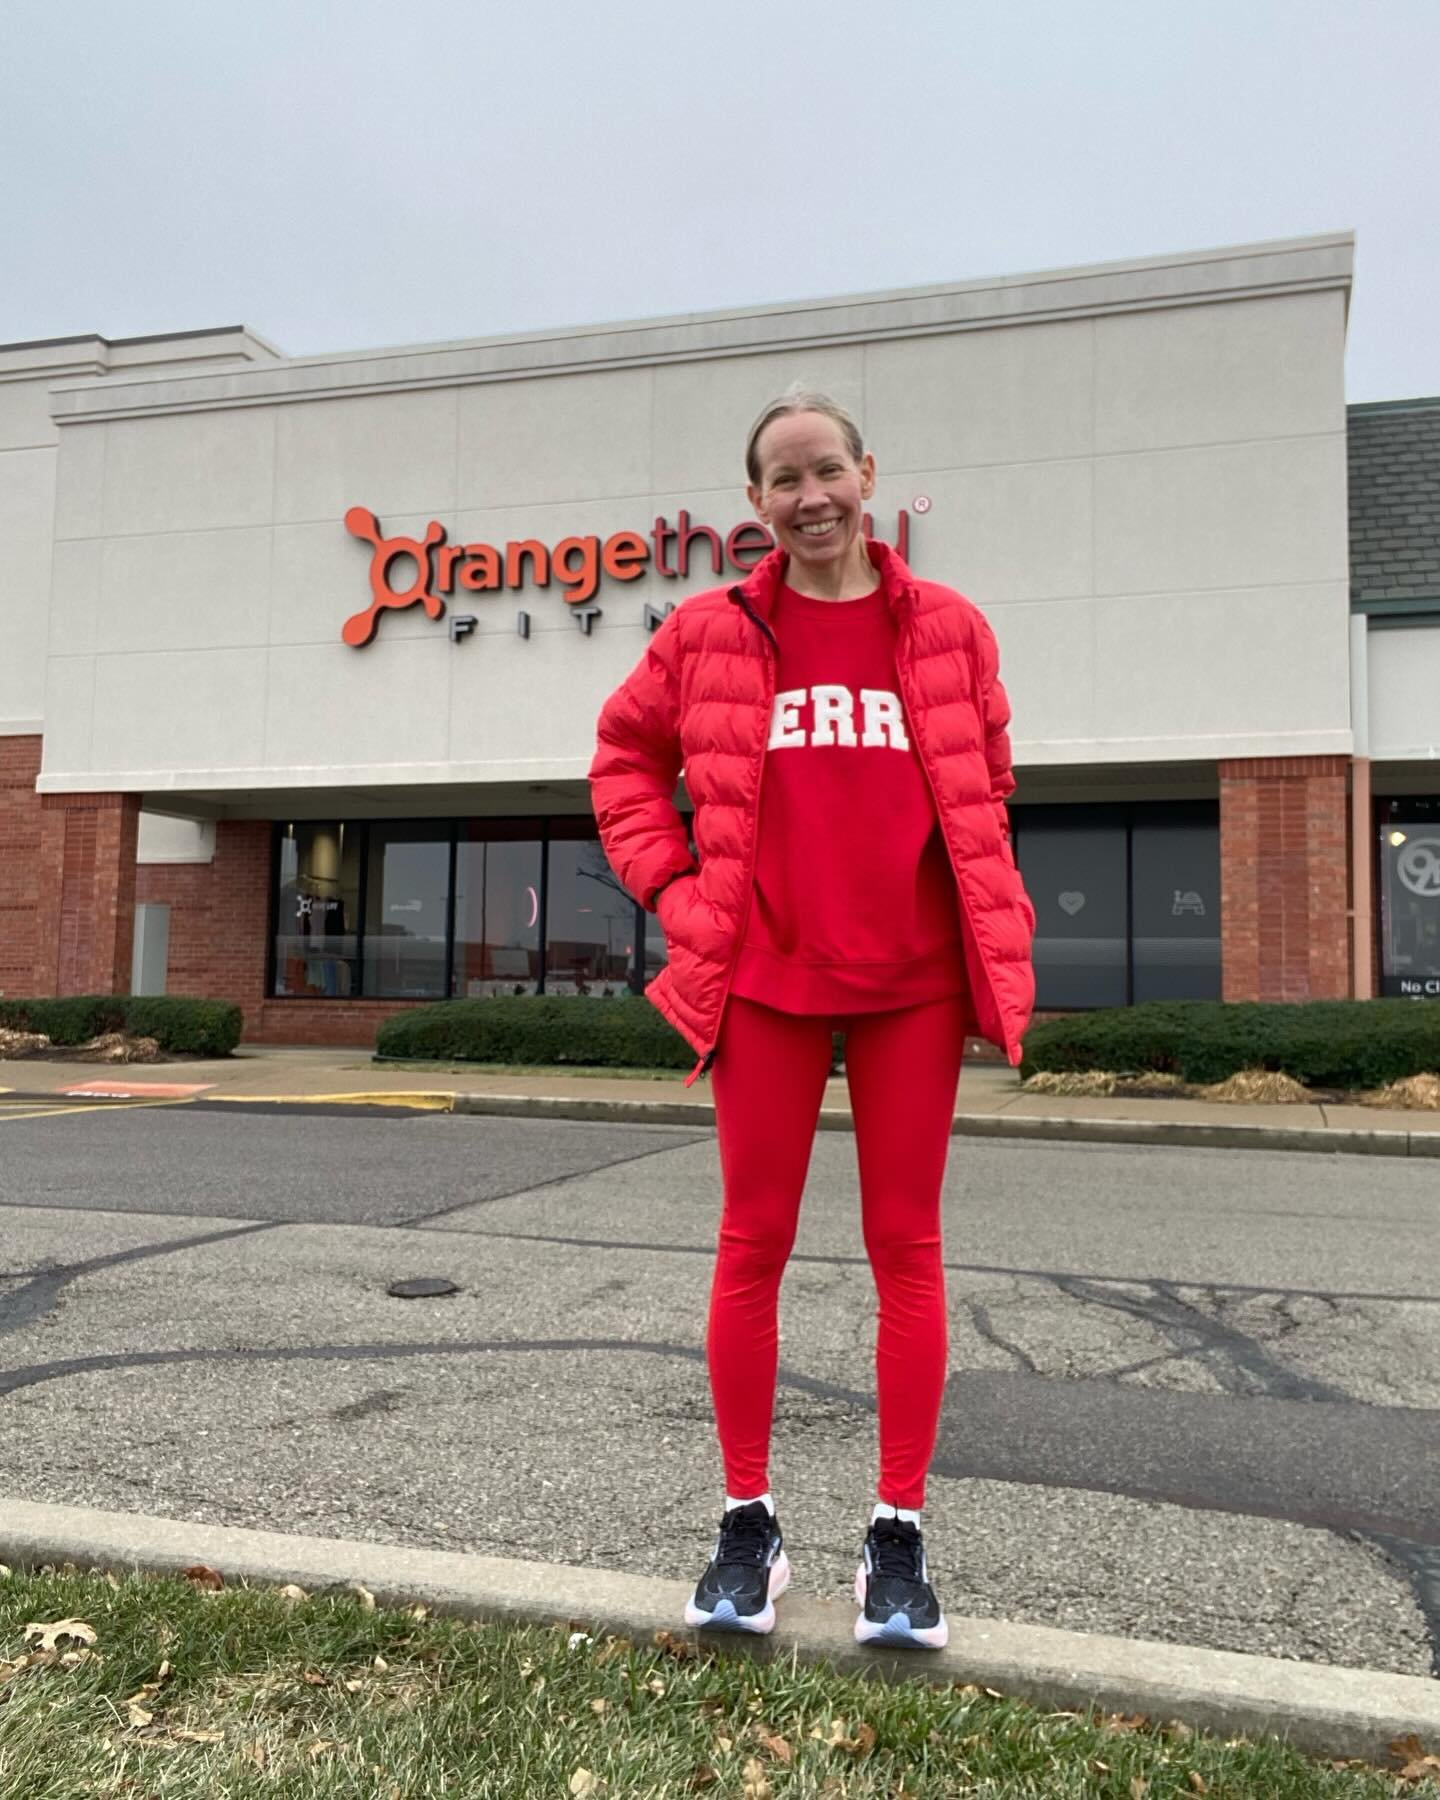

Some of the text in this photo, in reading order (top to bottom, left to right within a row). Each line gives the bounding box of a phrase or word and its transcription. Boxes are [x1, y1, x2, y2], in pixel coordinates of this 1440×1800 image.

[450, 602, 676, 643] FITN
[767, 685, 909, 752] ERR
[1401, 980, 1422, 994] No
